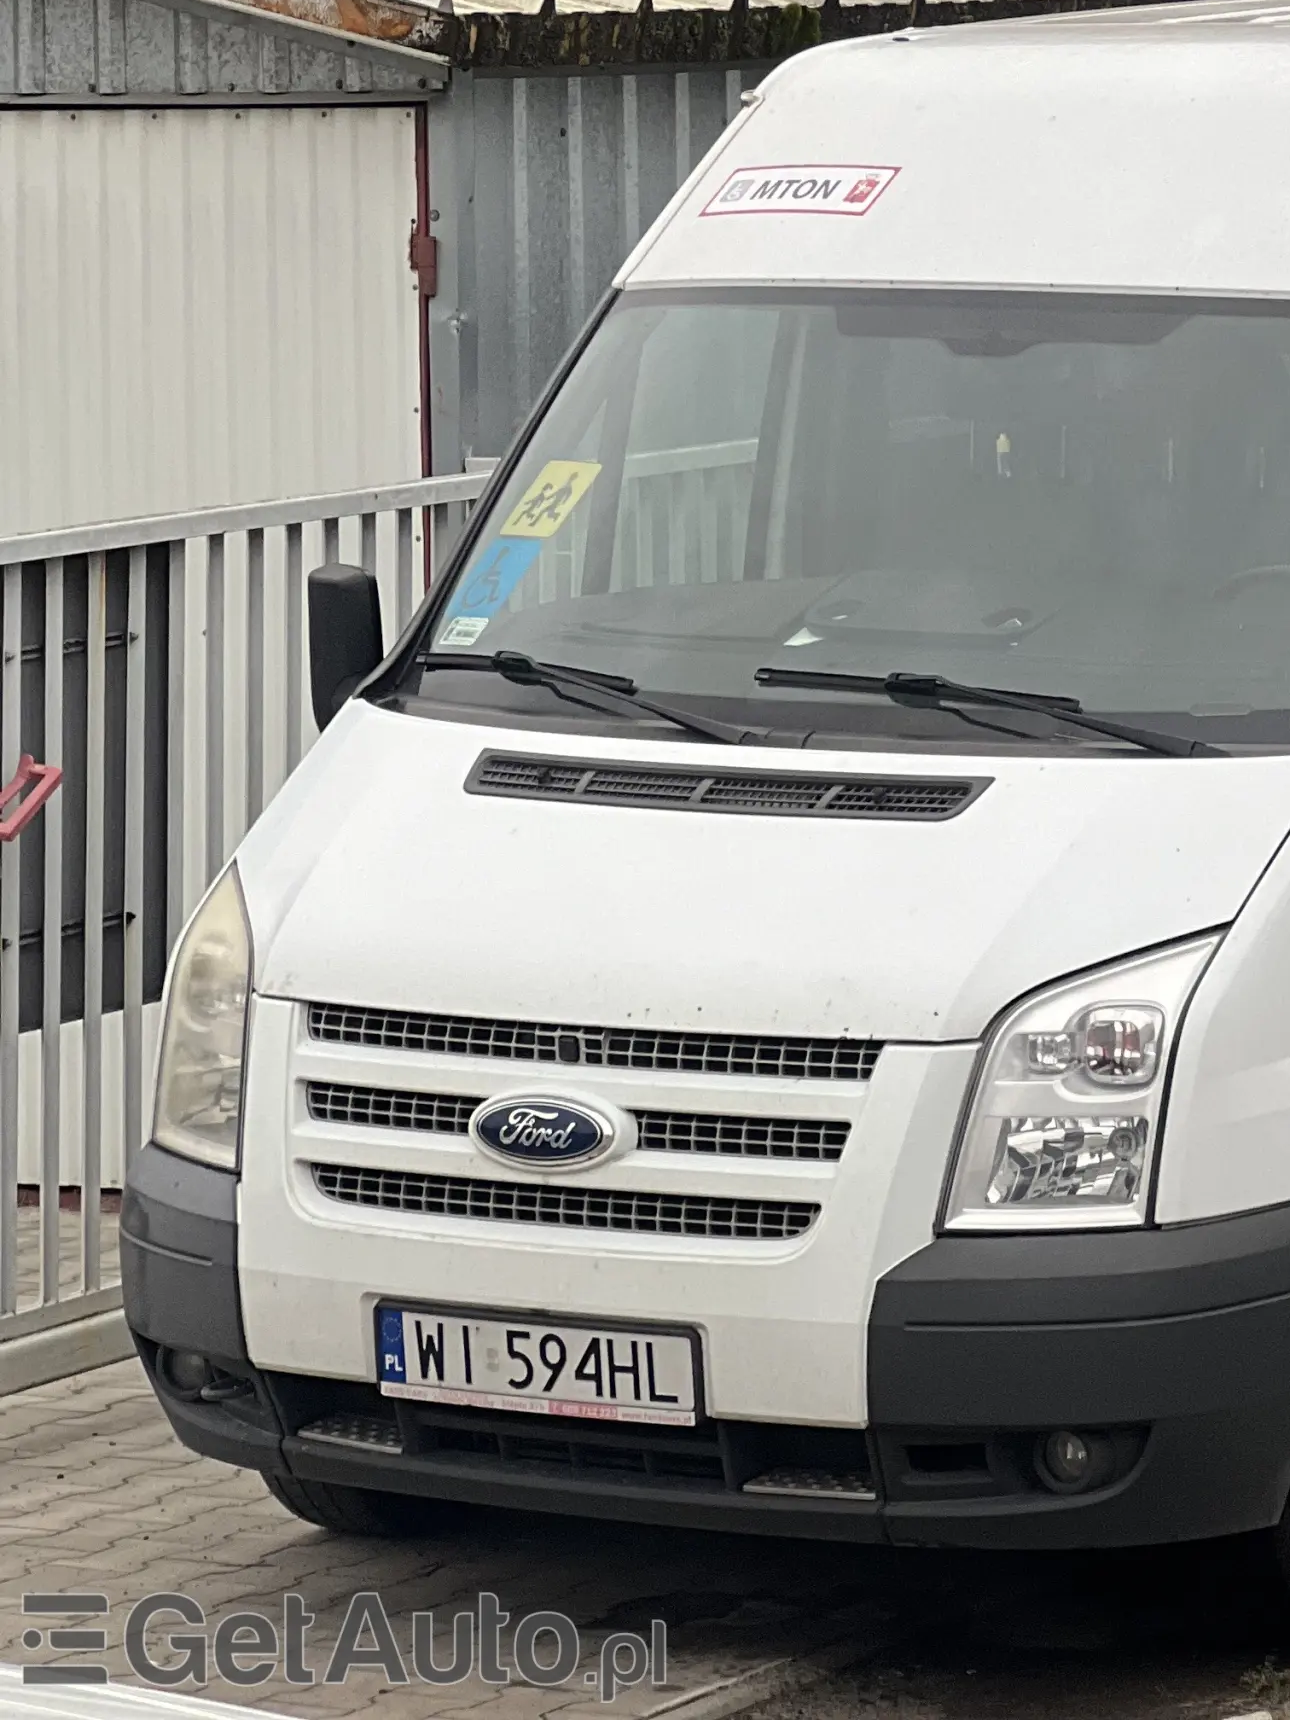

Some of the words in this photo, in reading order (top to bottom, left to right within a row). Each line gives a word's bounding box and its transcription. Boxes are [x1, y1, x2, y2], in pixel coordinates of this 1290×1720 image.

[750, 179, 842, 201] MTON
[499, 1107, 577, 1150] Ford
[384, 1353, 404, 1372] PL
[414, 1319, 474, 1385] WI
[505, 1329, 680, 1404] 594HL
